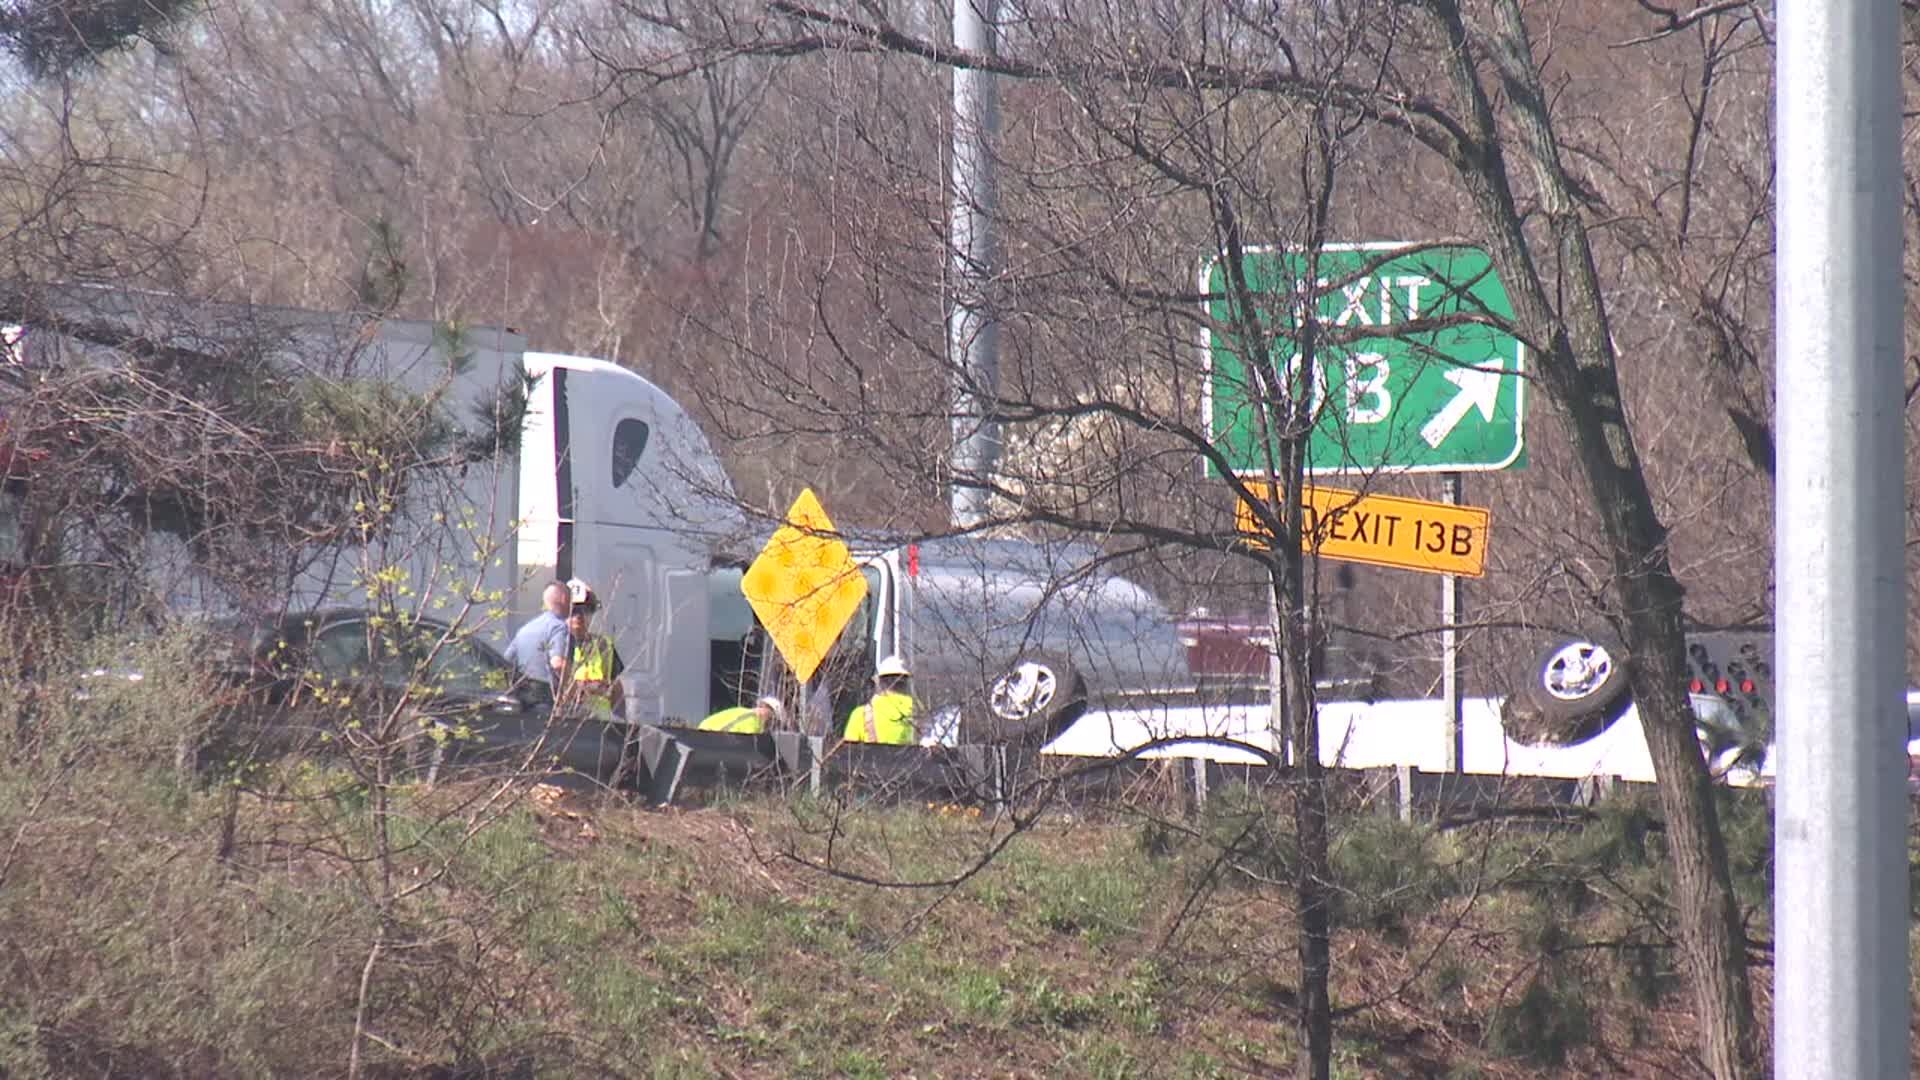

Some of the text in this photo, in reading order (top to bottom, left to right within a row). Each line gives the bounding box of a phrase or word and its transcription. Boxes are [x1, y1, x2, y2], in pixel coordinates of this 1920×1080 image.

[1296, 276, 1432, 327] EXIT
[1330, 509, 1402, 547] EXIT
[1415, 520, 1473, 556] 13B
